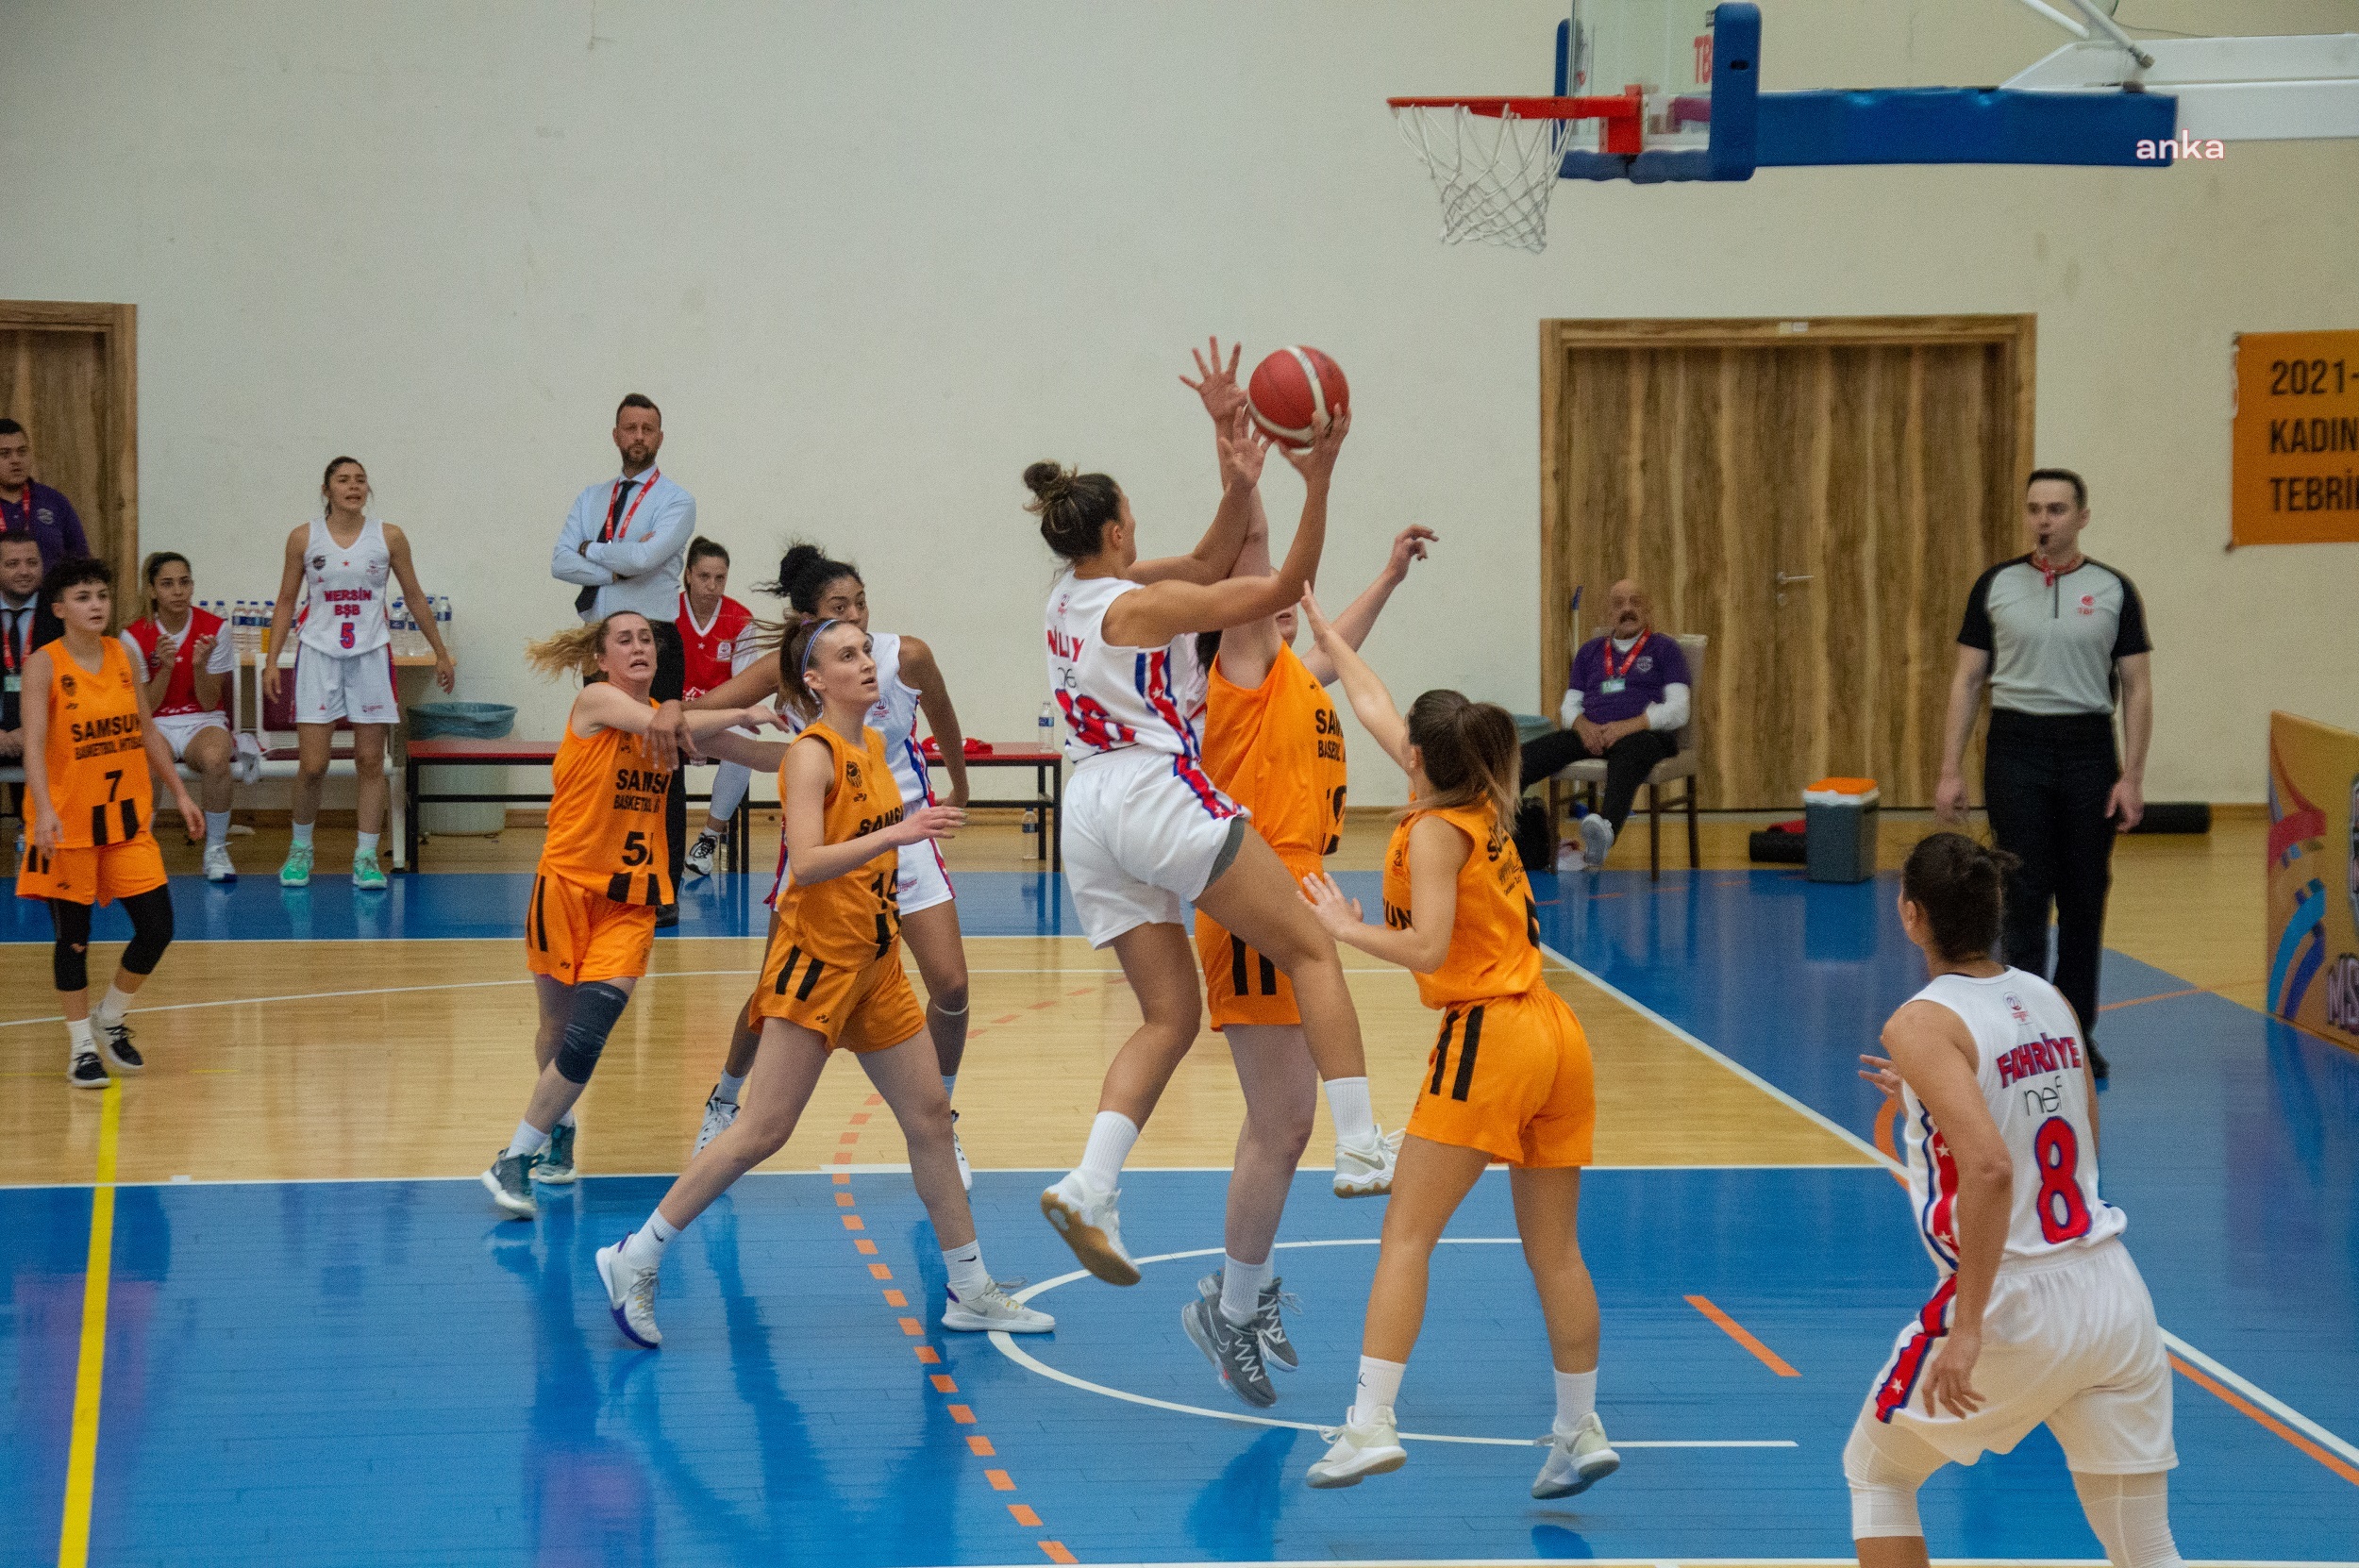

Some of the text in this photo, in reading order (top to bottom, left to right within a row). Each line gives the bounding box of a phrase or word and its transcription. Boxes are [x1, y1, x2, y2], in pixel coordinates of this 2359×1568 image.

[2270, 416, 2359, 453] KADIN
[2269, 468, 2359, 512] TEBRİ
[324, 587, 372, 602] MERSİN
[341, 622, 356, 649] 5
[105, 770, 123, 802] 7
[2024, 1076, 2063, 1116] nef
[2034, 1116, 2093, 1244] 8
